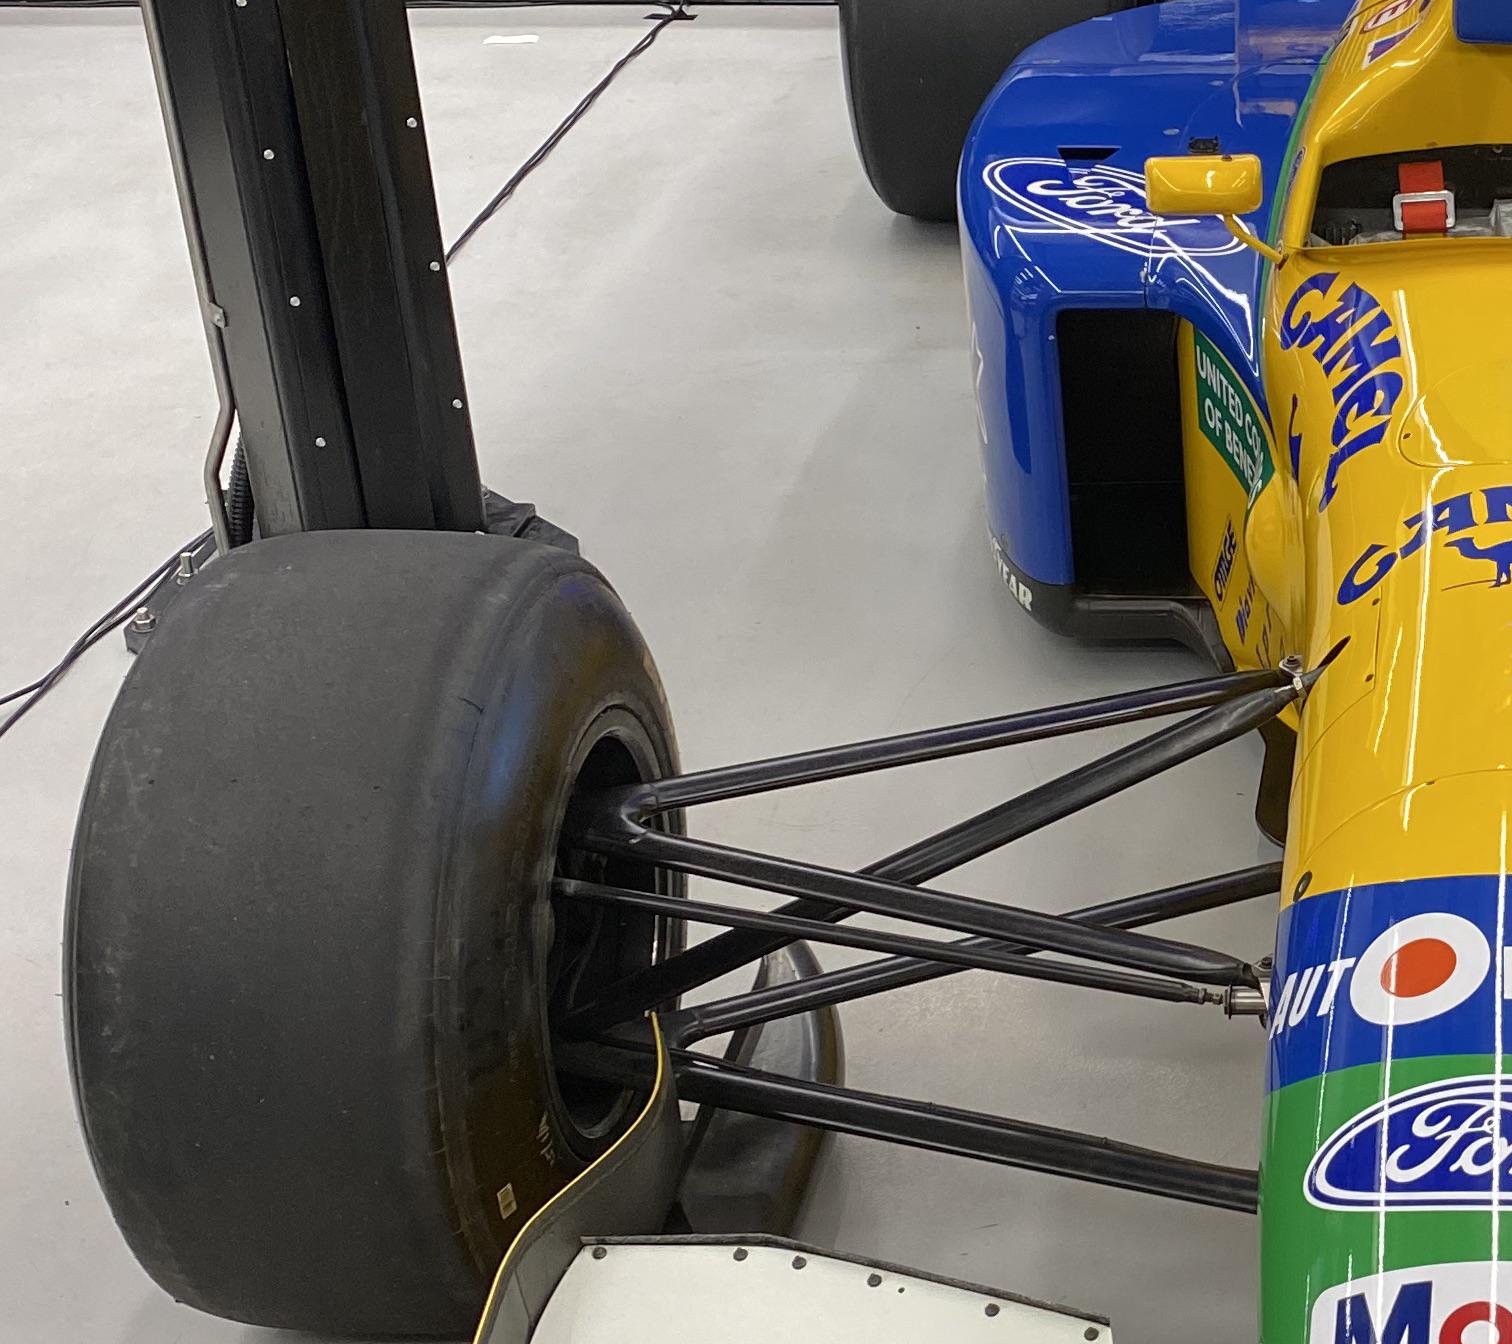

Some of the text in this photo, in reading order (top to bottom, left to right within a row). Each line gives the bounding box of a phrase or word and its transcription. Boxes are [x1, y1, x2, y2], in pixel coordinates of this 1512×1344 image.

[1026, 175, 1201, 231] Ford
[1196, 344, 1243, 428] UNITED
[1204, 397, 1223, 438] OF
[1280, 271, 1404, 513] CAMEL
